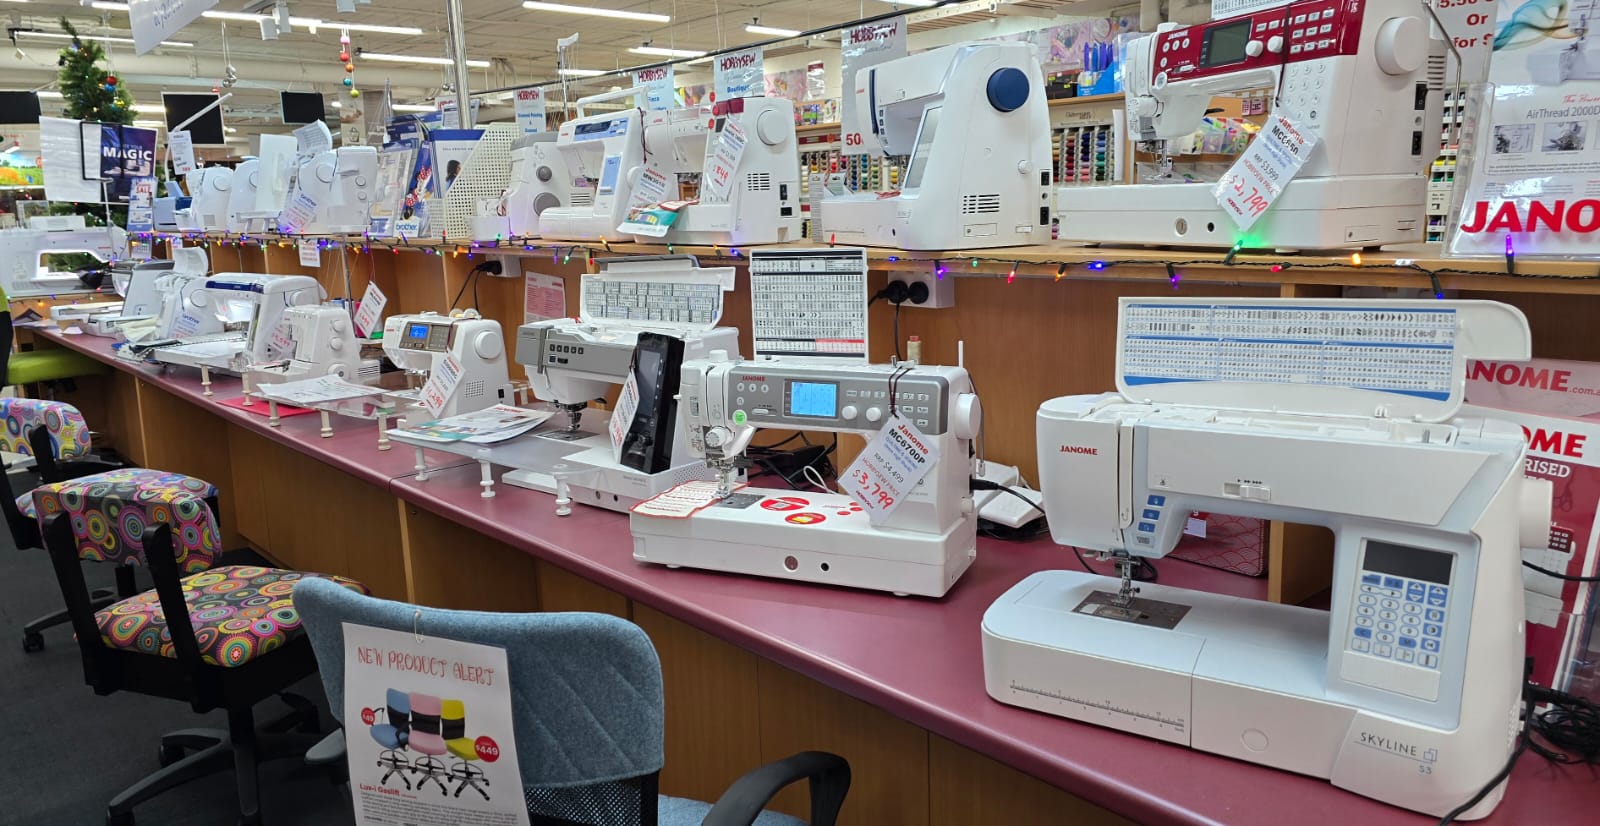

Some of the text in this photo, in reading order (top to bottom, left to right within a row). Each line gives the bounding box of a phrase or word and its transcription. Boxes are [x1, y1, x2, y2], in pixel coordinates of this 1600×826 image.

[1466, 14, 1488, 26] Or
[1454, 37, 1477, 48] for
[720, 52, 756, 72] HOBBYSEW
[1526, 108, 1568, 120] AirThread
[103, 146, 152, 160] MAGIC
[1230, 175, 1268, 217] $2,799
[1460, 199, 1600, 233] JANO
[1466, 360, 1571, 392] NOME
[889, 428, 925, 464] MC6700P
[898, 424, 928, 454] Janome
[1060, 445, 1098, 455] JANOME
[884, 462, 904, 484] $4,499
[852, 470, 894, 510] $3,799
[358, 646, 494, 686] NEW PRODUCT ALERT
[476, 745, 499, 756] $449
[1360, 732, 1417, 756] SKYLINE
[1418, 765, 1432, 775] S3
